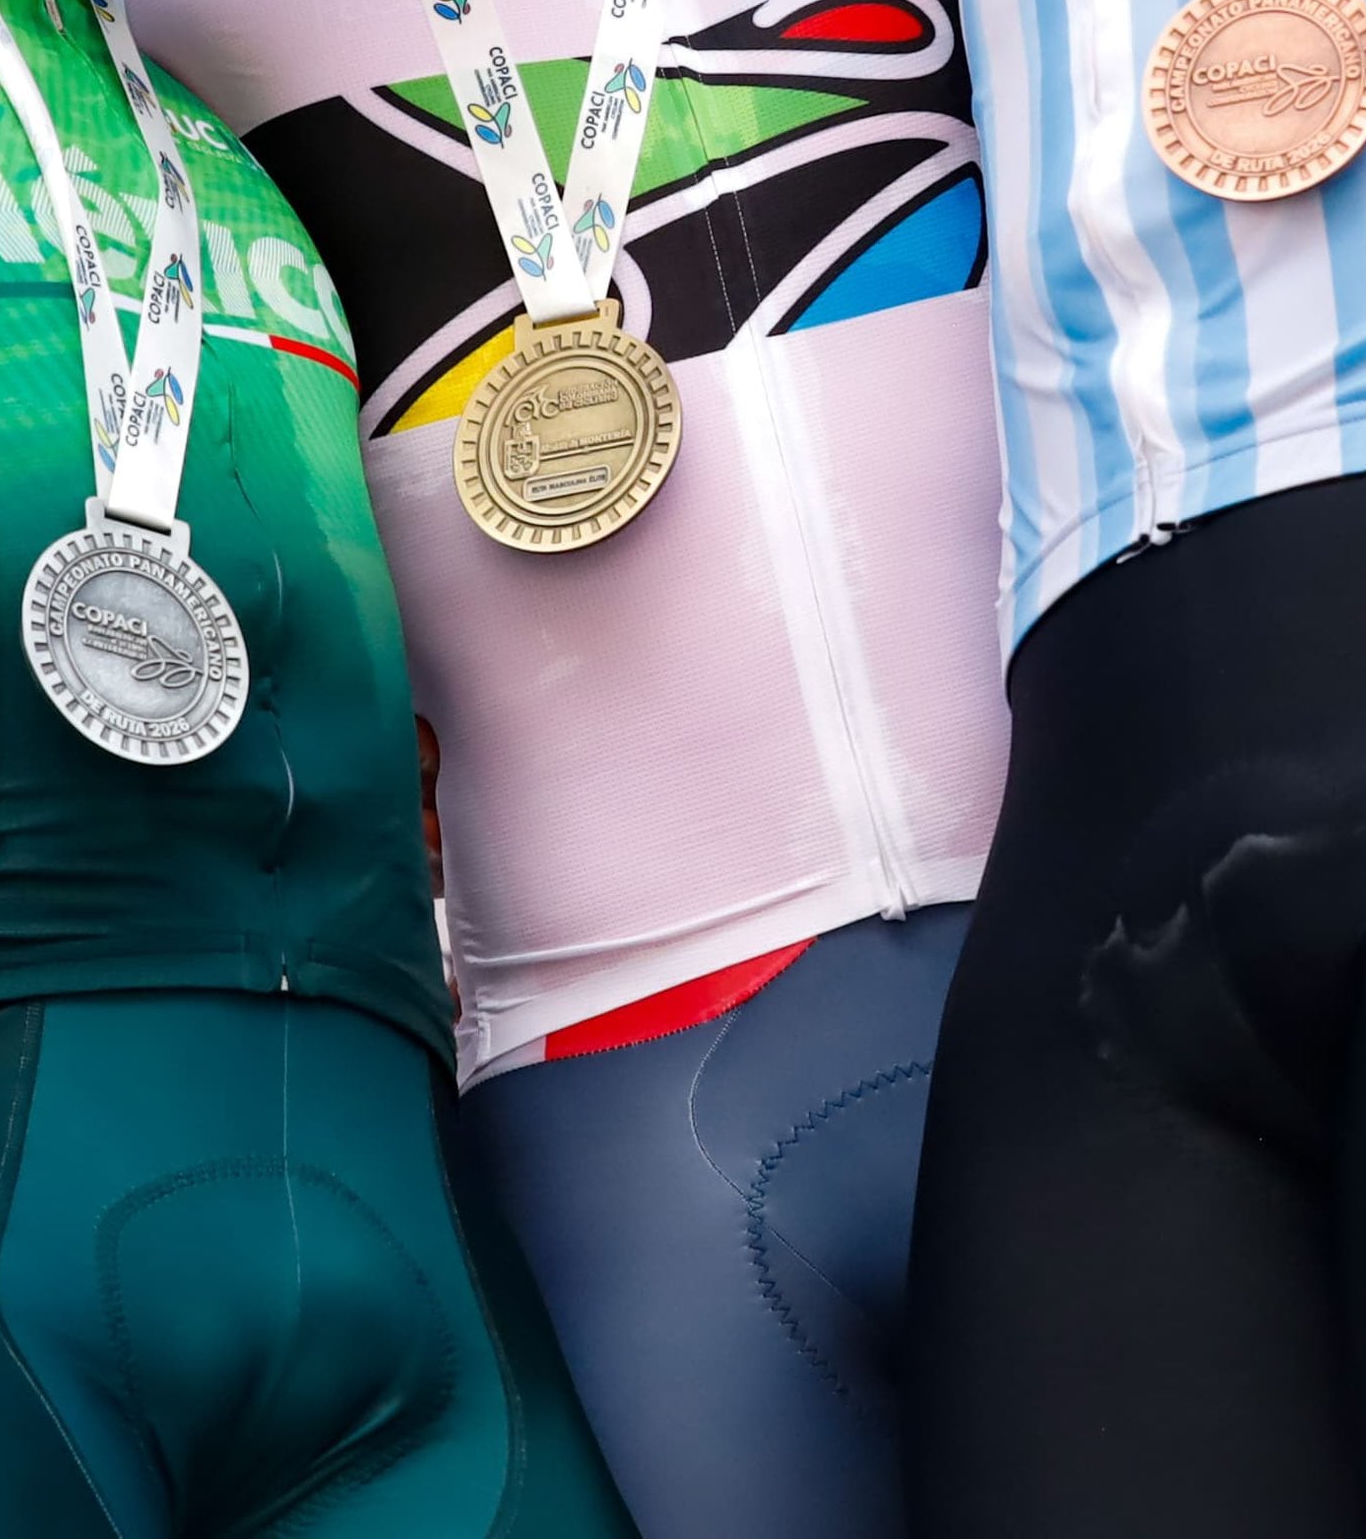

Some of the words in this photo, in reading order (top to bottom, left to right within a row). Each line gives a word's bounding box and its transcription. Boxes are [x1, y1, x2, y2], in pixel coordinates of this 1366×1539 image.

[489, 47, 518, 99] COPACI
[1192, 54, 1277, 86] COPACI
[581, 91, 606, 149] COPACI
[532, 173, 559, 230] COPACI
[76, 225, 102, 287] COPACI
[148, 272, 166, 324] COPACI
[125, 392, 147, 446] COPACI
[48, 553, 124, 638] CAMPEONATO
[129, 555, 223, 683] PANAMERICANO
[71, 601, 149, 637] COPACI
